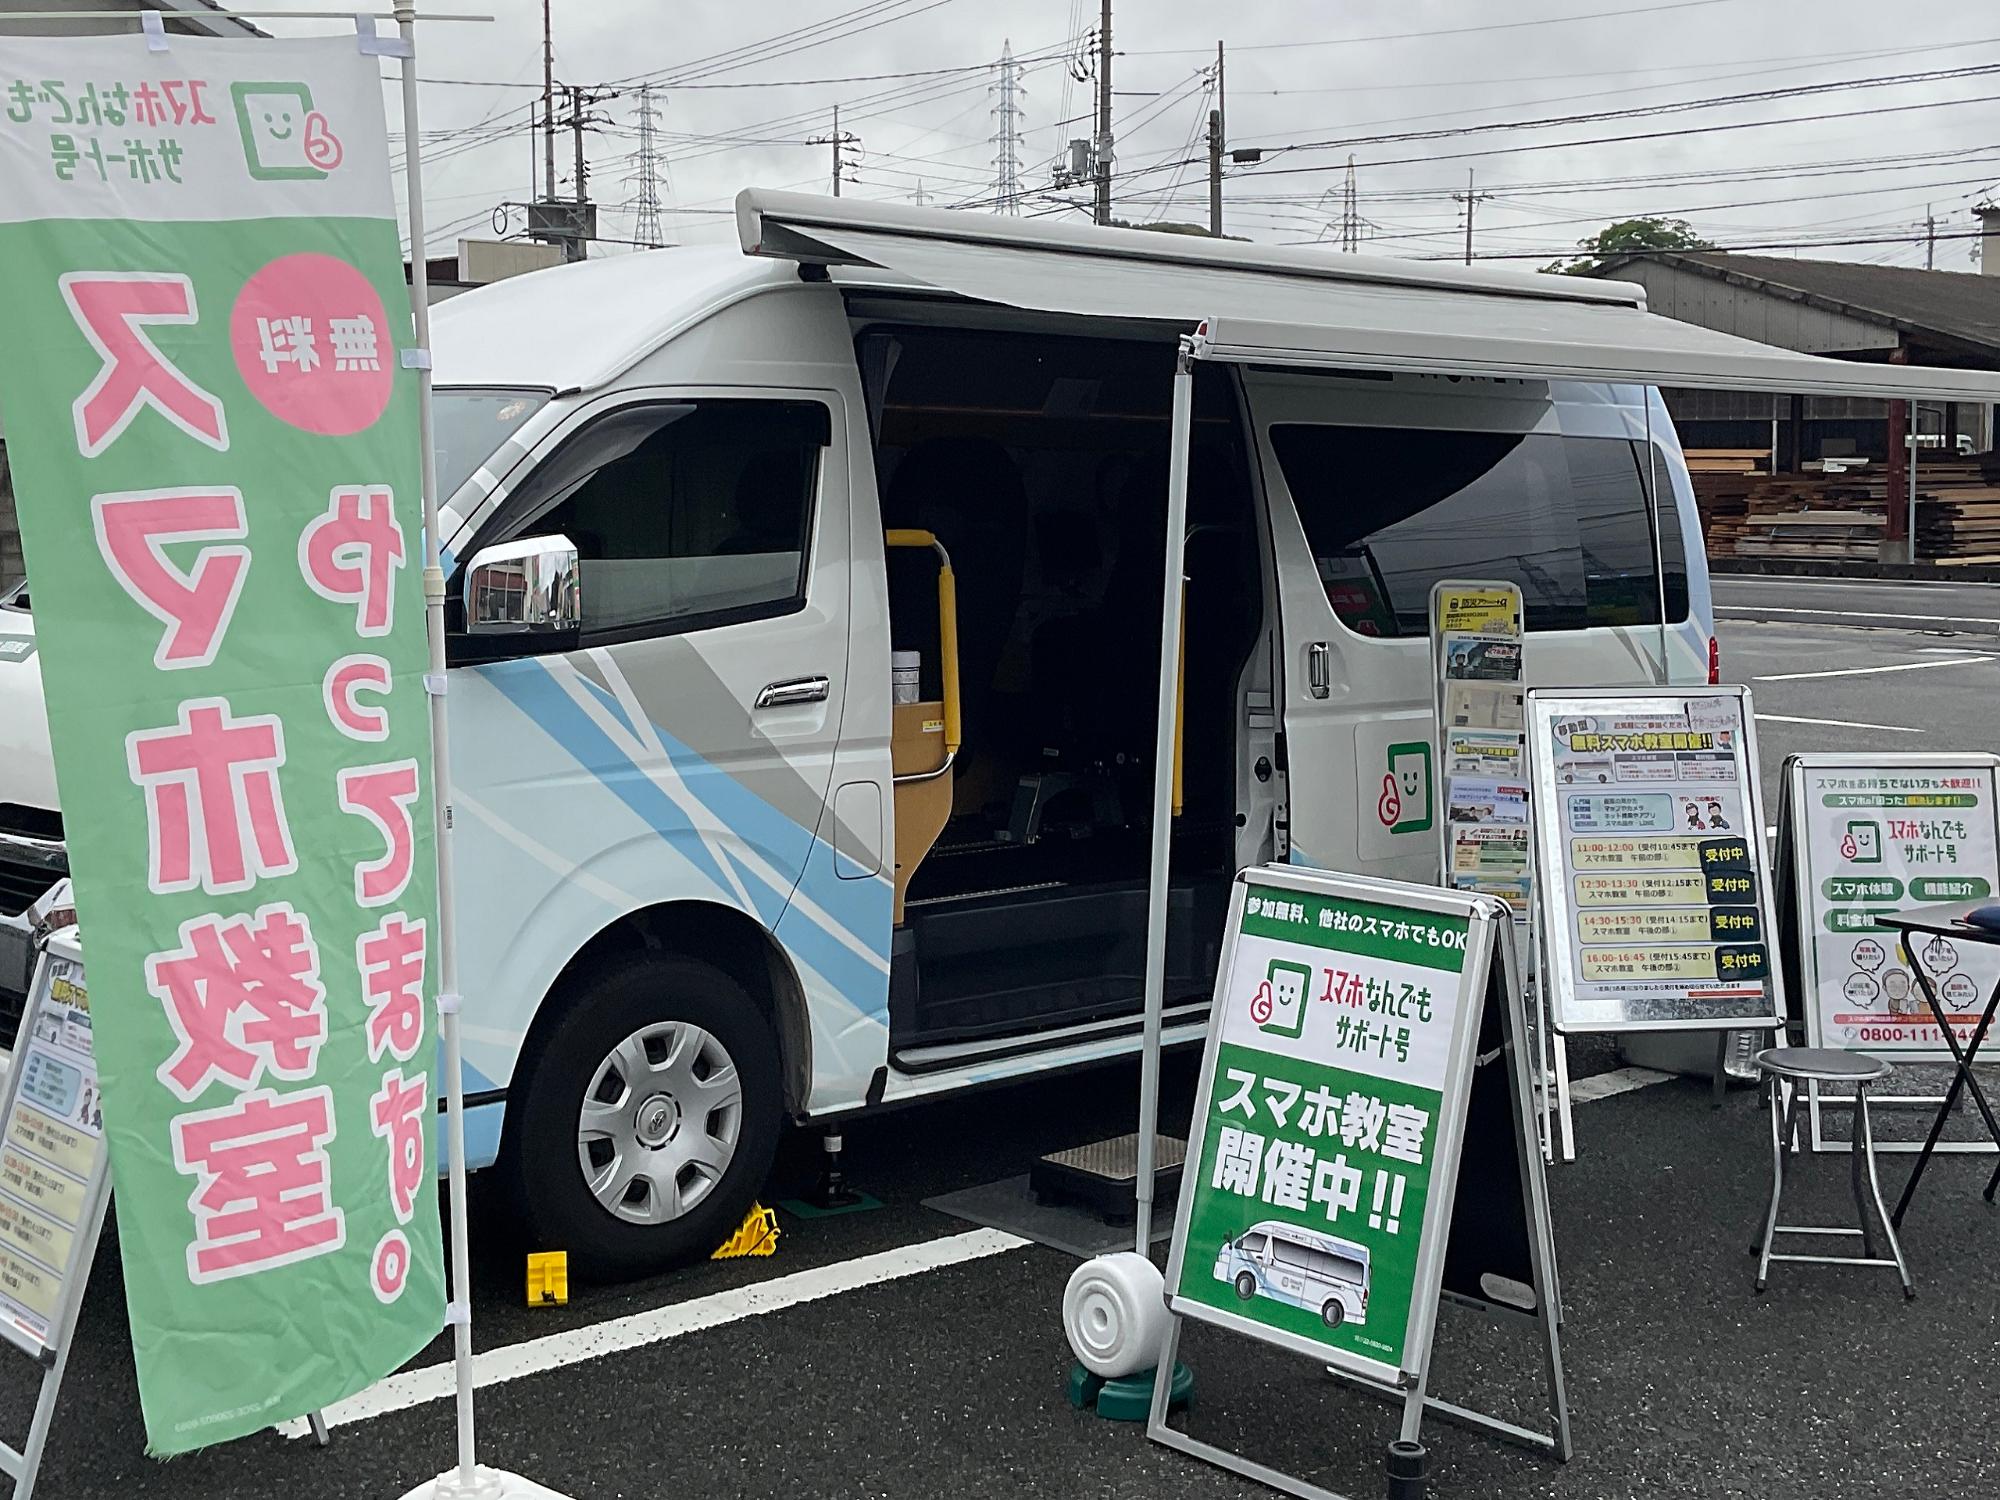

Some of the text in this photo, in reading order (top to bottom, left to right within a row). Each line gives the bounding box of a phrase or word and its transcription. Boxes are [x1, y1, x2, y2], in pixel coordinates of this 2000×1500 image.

[1888, 820, 1967, 840] スマホなんでも
[1705, 847, 1743, 862] 受付中
[1904, 844, 1957, 863] サポート号
[1711, 878, 1750, 892] 受付中
[1832, 883, 1894, 895] スマホ体験
[1248, 897, 1468, 951] 参加無料、他社のスマホでもOK
[1715, 915, 1754, 929] 受付中
[1722, 954, 1761, 968] 受付中
[1320, 968, 1433, 1023] スマホなんでも
[1337, 1015, 1411, 1062] サポート号
[1218, 1068, 1429, 1165] スマホ教室
[1212, 1126, 1406, 1234] 開催中!!
